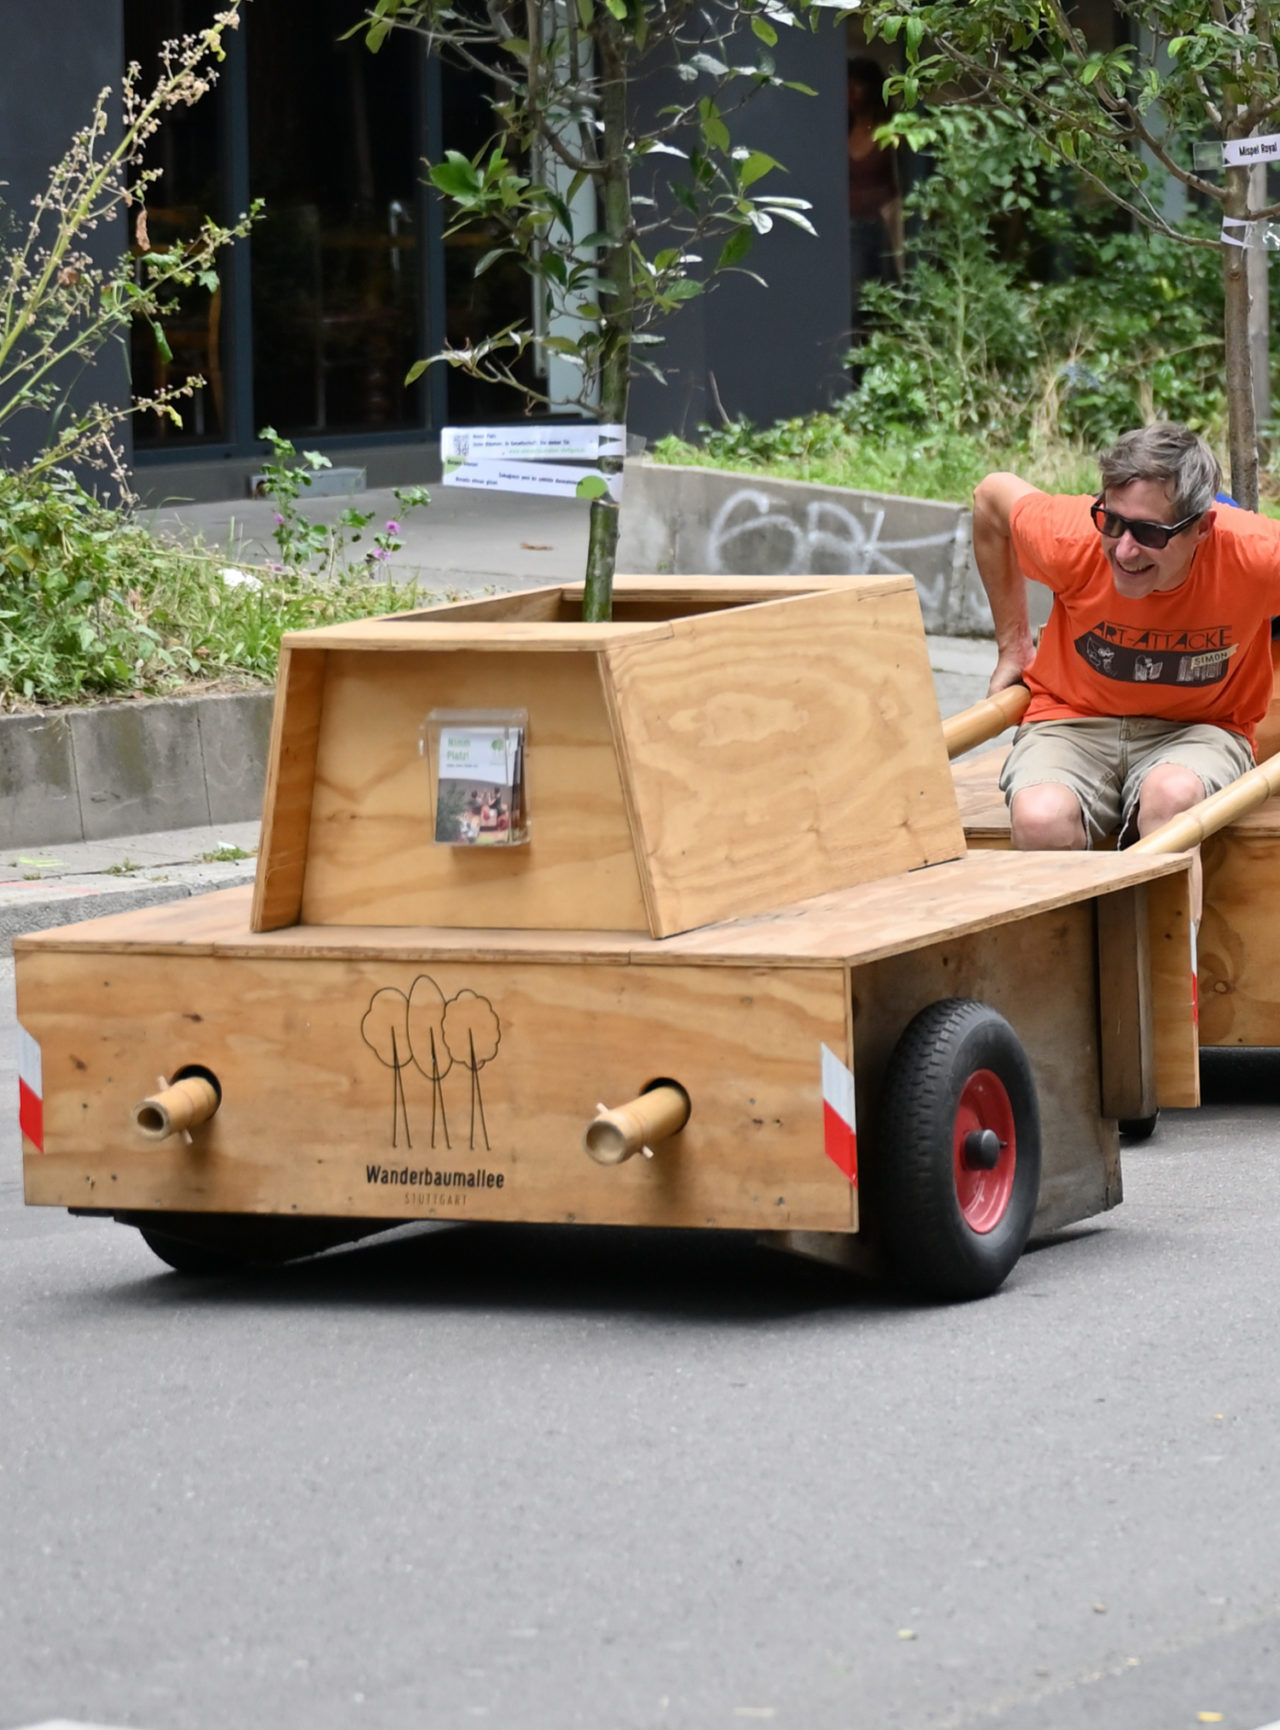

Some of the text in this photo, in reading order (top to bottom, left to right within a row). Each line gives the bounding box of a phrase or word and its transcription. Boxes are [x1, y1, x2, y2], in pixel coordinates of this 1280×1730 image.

[1239, 142, 1278, 157] Mispel Royal
[1092, 621, 1233, 650] ART-ATTACKE
[1193, 652, 1229, 667] SIMON
[366, 1164, 505, 1189] Wanderbaumallee
[404, 1192, 467, 1206] STUTTGART
